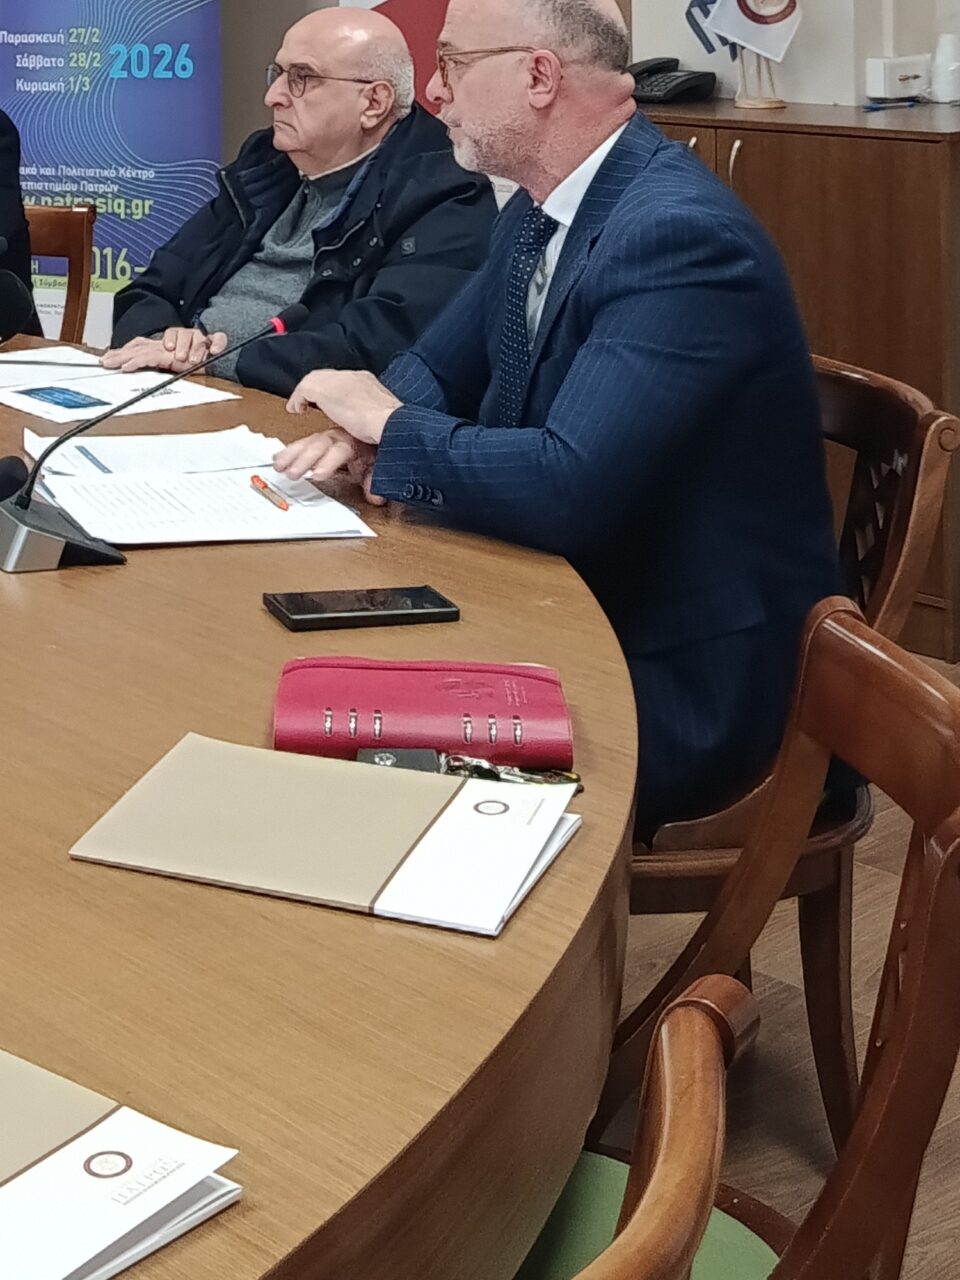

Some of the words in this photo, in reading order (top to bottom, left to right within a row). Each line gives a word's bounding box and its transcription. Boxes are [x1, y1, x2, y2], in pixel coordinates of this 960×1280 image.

[0, 30, 65, 45] Παρασκευή
[68, 27, 100, 45] 27/2
[16, 54, 65, 69] Σάββατο
[68, 51, 101, 70] 28/2
[108, 43, 194, 79] 2026
[16, 78, 65, 94] Κυριακή
[68, 75, 90, 94] 1/3
[40, 165, 56, 176] και
[119, 166, 155, 180] Κέντρο
[20, 180, 78, 192] επιστημίου
[80, 181, 119, 194] Πατρών
